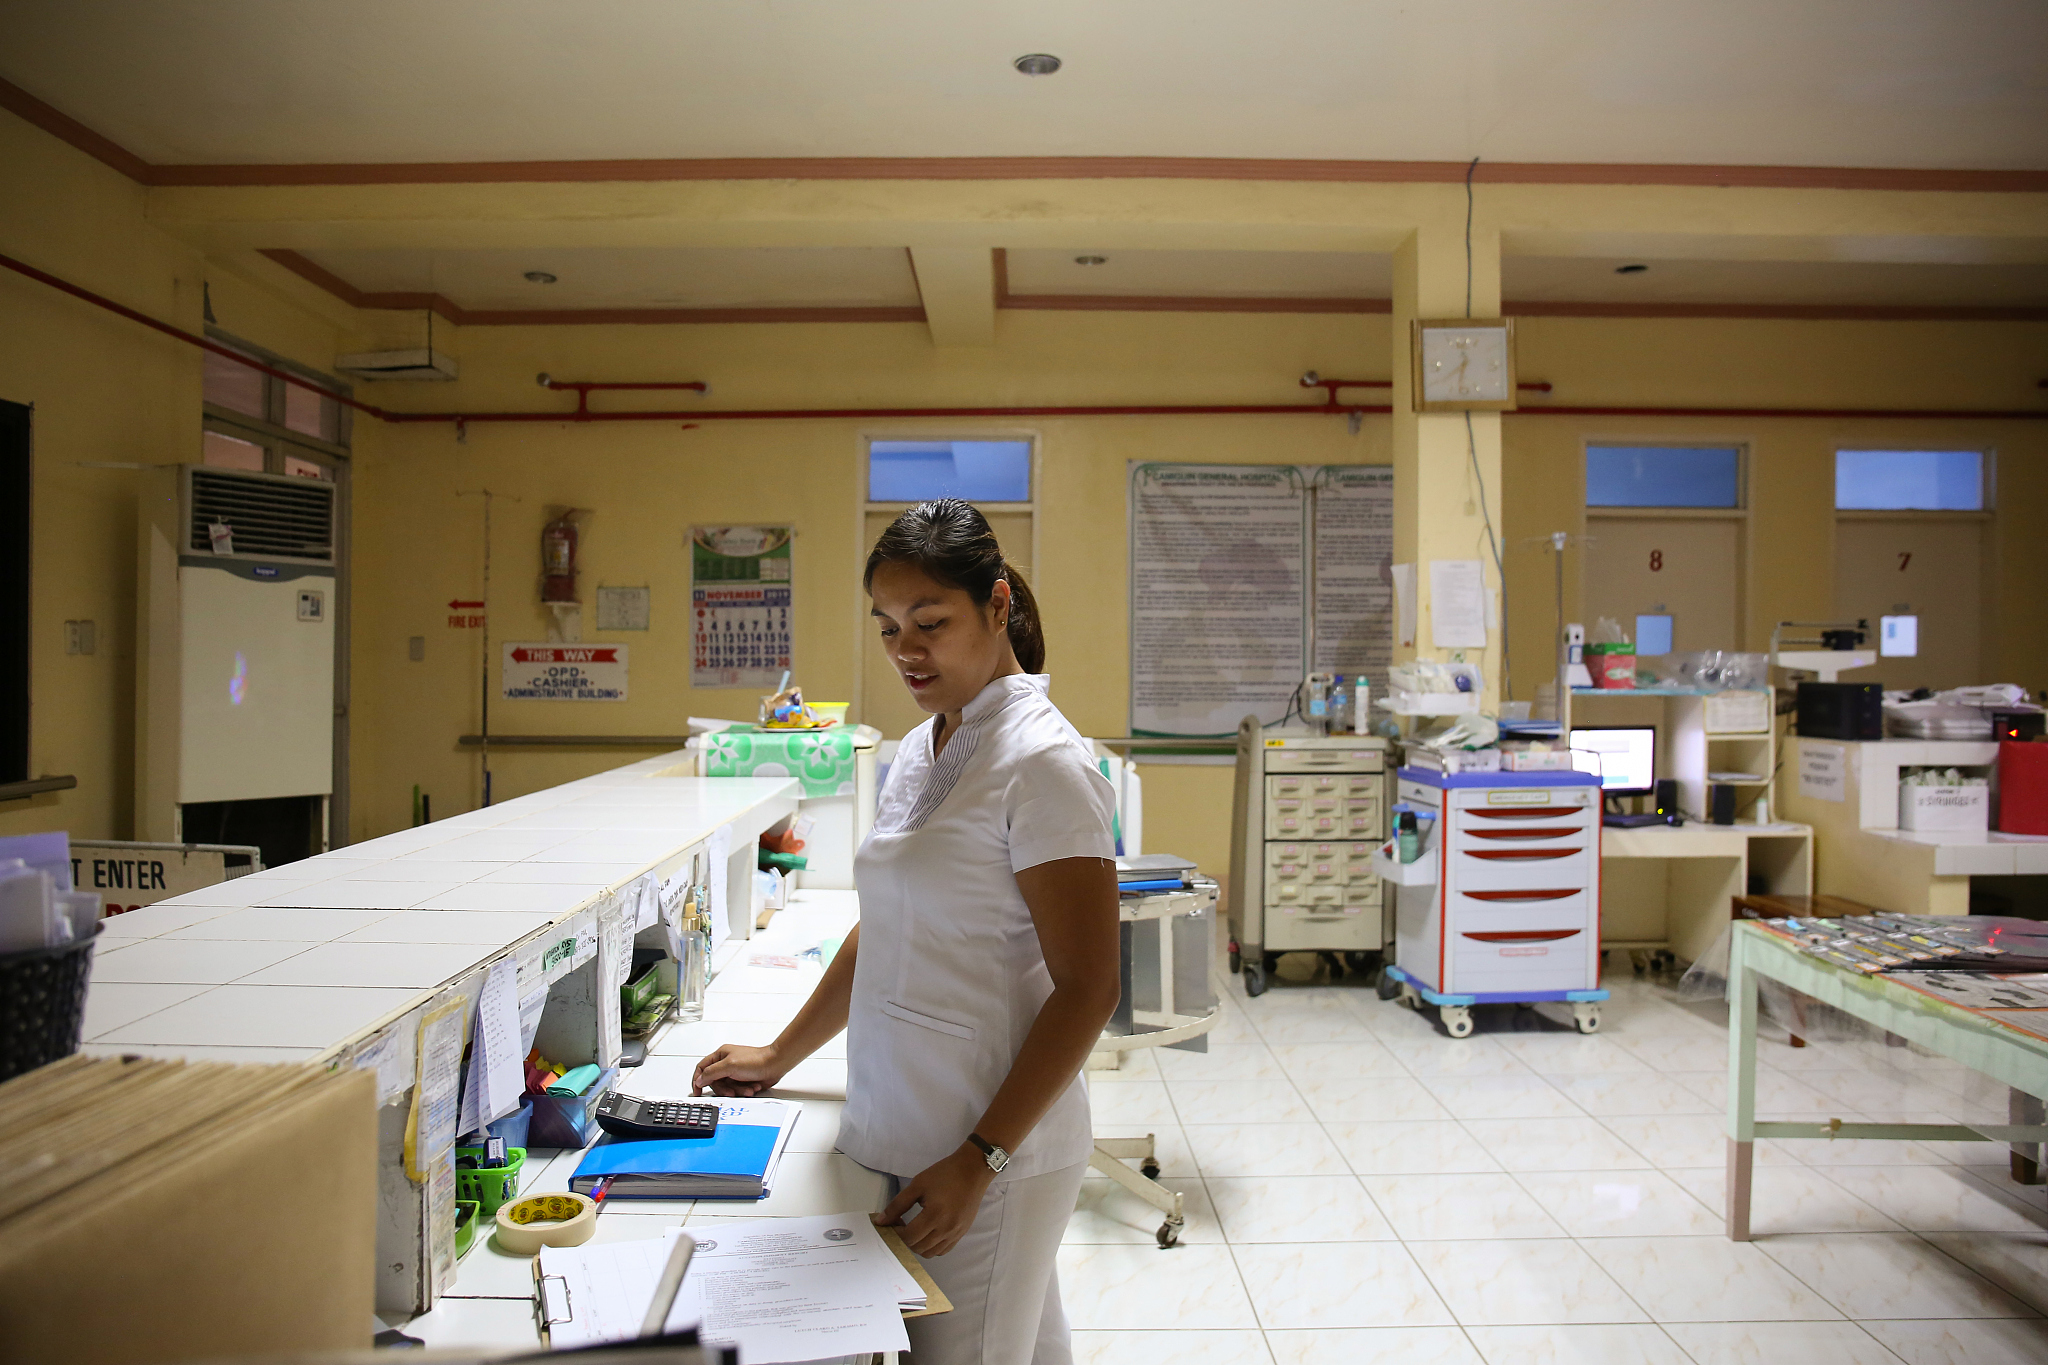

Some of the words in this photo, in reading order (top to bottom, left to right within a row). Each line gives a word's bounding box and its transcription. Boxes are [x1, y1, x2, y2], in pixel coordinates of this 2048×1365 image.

[1649, 549, 1662, 571] 8
[1896, 551, 1912, 571] 7
[707, 591, 762, 599] NOVEMBER
[447, 615, 467, 629] FIRE
[696, 633, 707, 643] 10
[709, 633, 720, 643] 11
[723, 633, 734, 643] 12
[737, 633, 748, 643] 13
[750, 633, 762, 643] 14
[764, 633, 776, 643] 15
[778, 633, 790, 643] 16
[526, 649, 555, 661] THIS
[563, 649, 596, 661] WAY
[696, 645, 707, 655] 17
[709, 645, 721, 655] 18
[723, 645, 734, 655] 19
[737, 645, 748, 655] 20
[750, 645, 761, 655] 21
[764, 645, 776, 655] 22
[778, 645, 790, 655] 23
[696, 657, 707, 668] 24
[709, 657, 721, 668] 25
[722, 657, 735, 668] 26
[737, 657, 748, 668] 27
[750, 657, 762, 668] 28
[764, 657, 776, 668] 29
[778, 657, 790, 668] 30
[548, 667, 580, 677] OPD
[532, 678, 589, 688] CASHIER
[507, 688, 574, 698] ADMINISTRATIVE
[577, 688, 619, 699] BUILDING
[93, 858, 167, 890] ENTER
